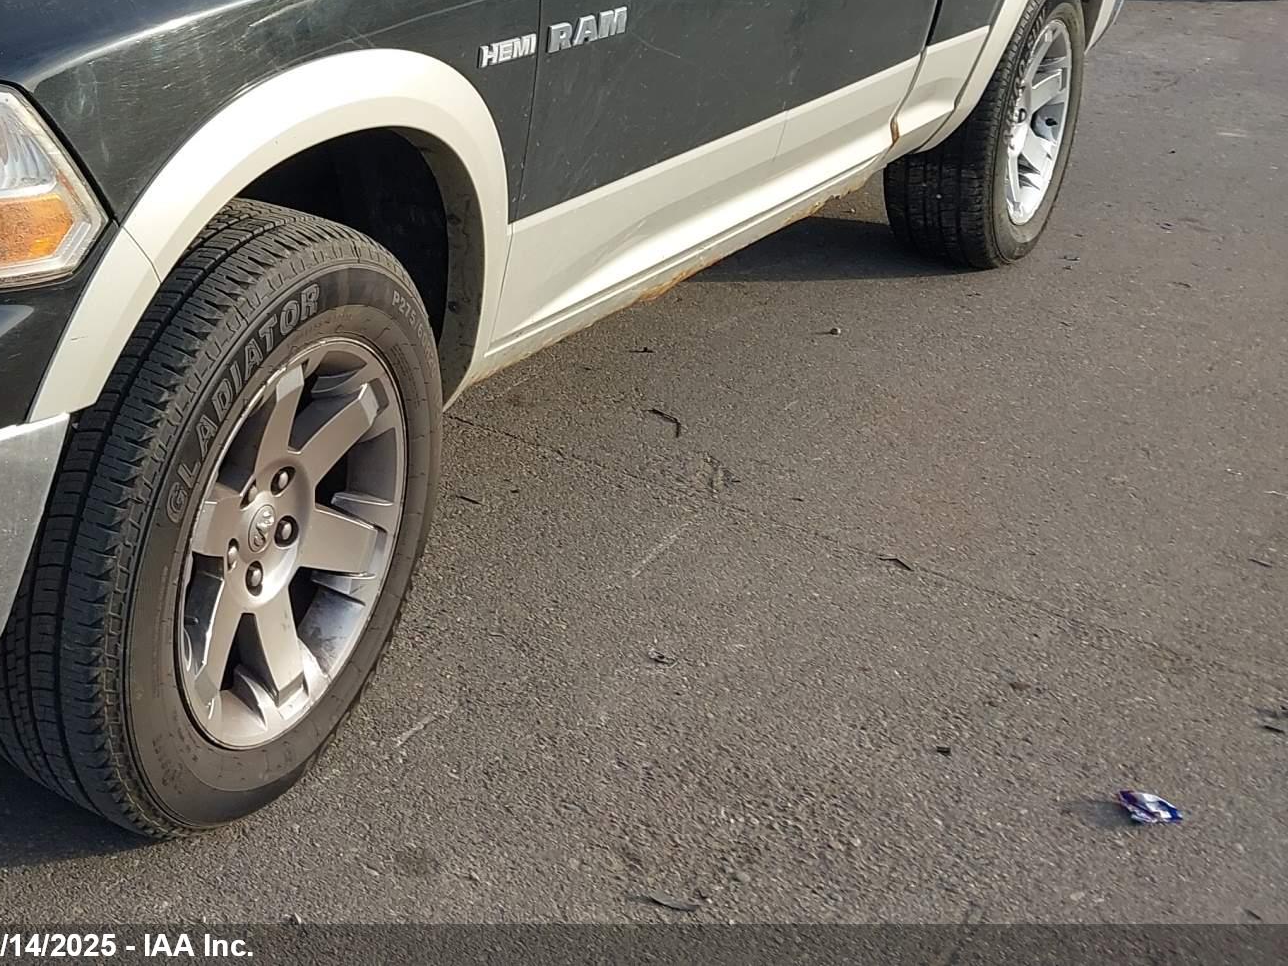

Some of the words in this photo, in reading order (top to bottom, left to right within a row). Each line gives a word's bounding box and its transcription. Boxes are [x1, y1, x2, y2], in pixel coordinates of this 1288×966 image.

[478, 33, 537, 69] HEMI
[546, 7, 628, 53] RAM
[167, 283, 320, 524] GLADIATOR
